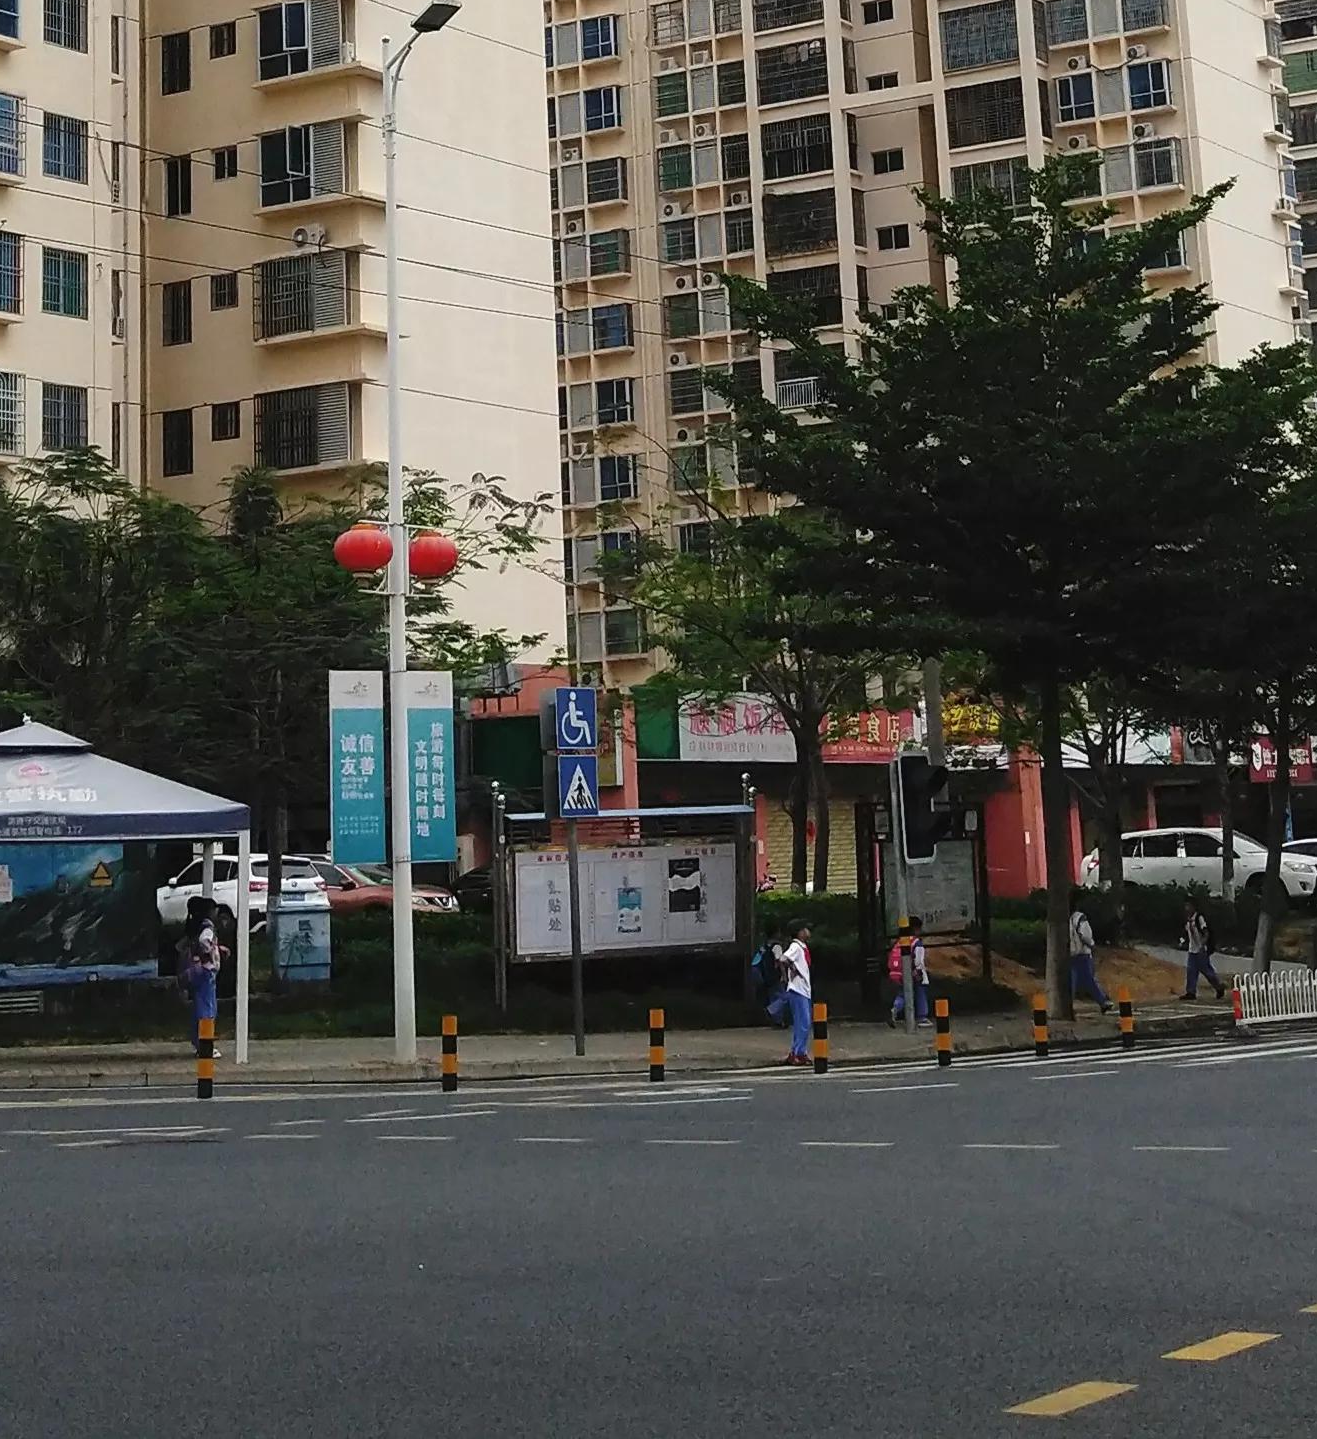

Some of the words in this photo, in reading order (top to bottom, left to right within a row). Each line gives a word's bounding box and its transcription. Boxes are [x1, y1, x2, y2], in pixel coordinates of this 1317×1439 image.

[340, 734, 375, 753] 诚信
[340, 756, 376, 776] 友善
[414, 739, 430, 838] 文明随时随地
